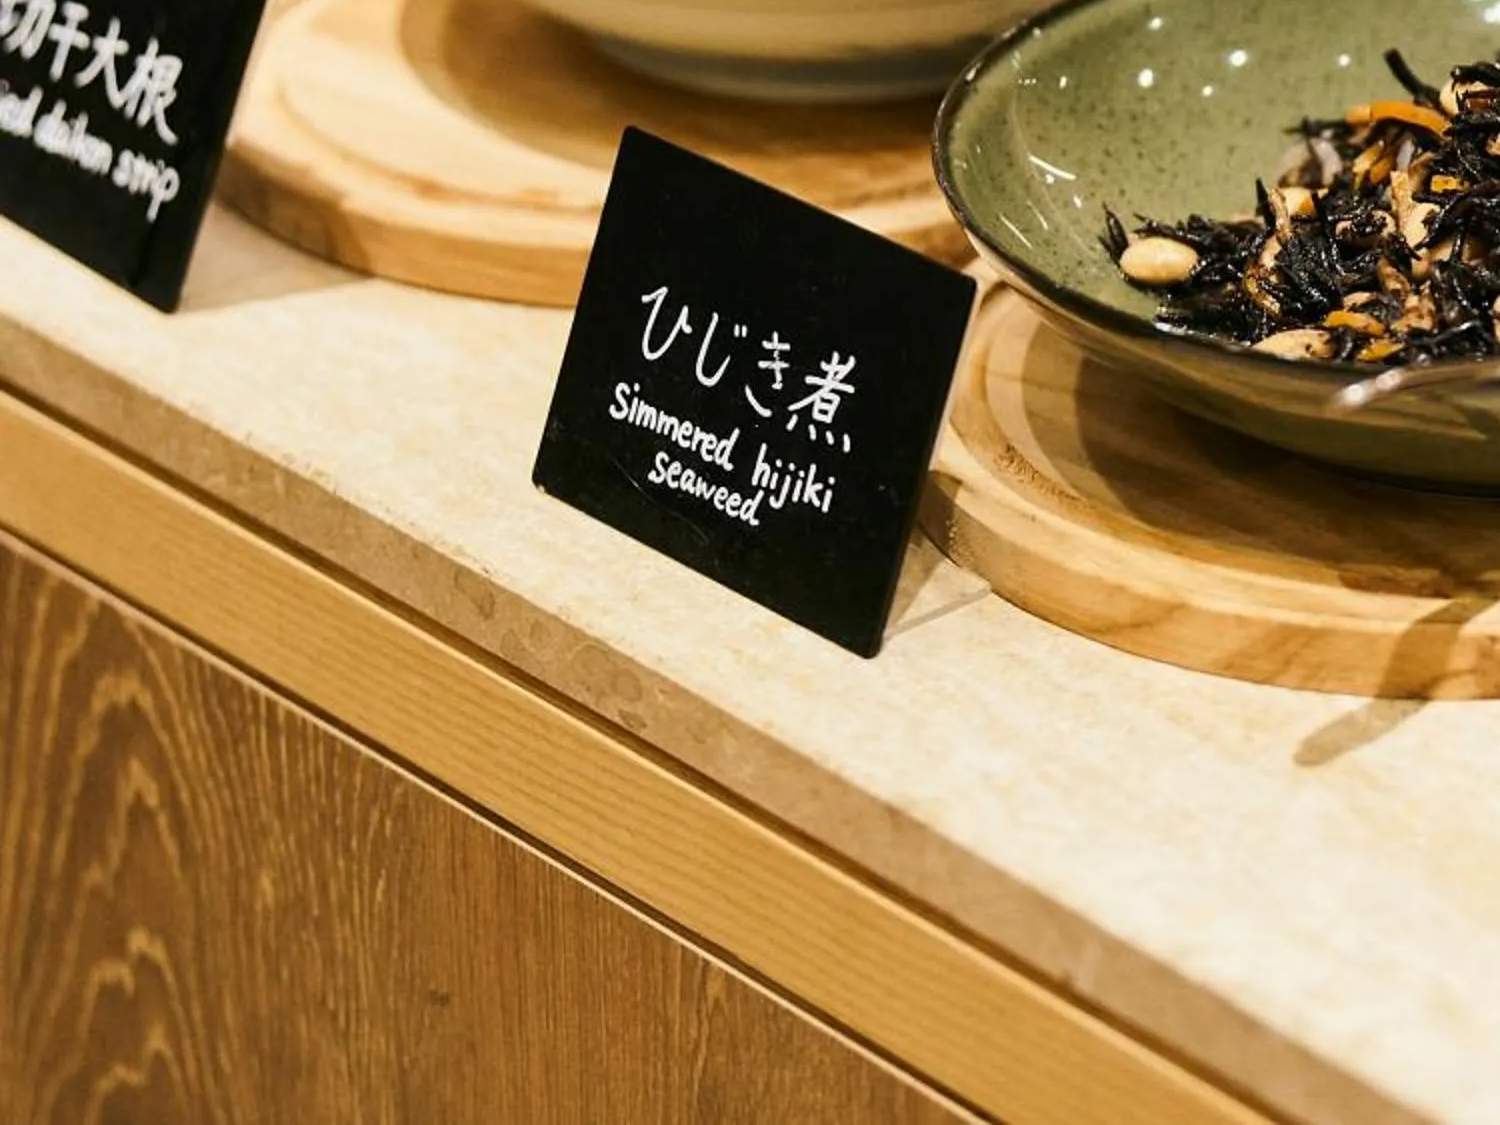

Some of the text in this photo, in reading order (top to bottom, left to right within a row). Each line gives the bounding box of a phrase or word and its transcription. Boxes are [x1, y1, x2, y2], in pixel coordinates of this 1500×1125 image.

[641, 286, 856, 453] ひじき煮
[609, 382, 836, 513] Simmered hijiki
[648, 451, 764, 526] seaweed
